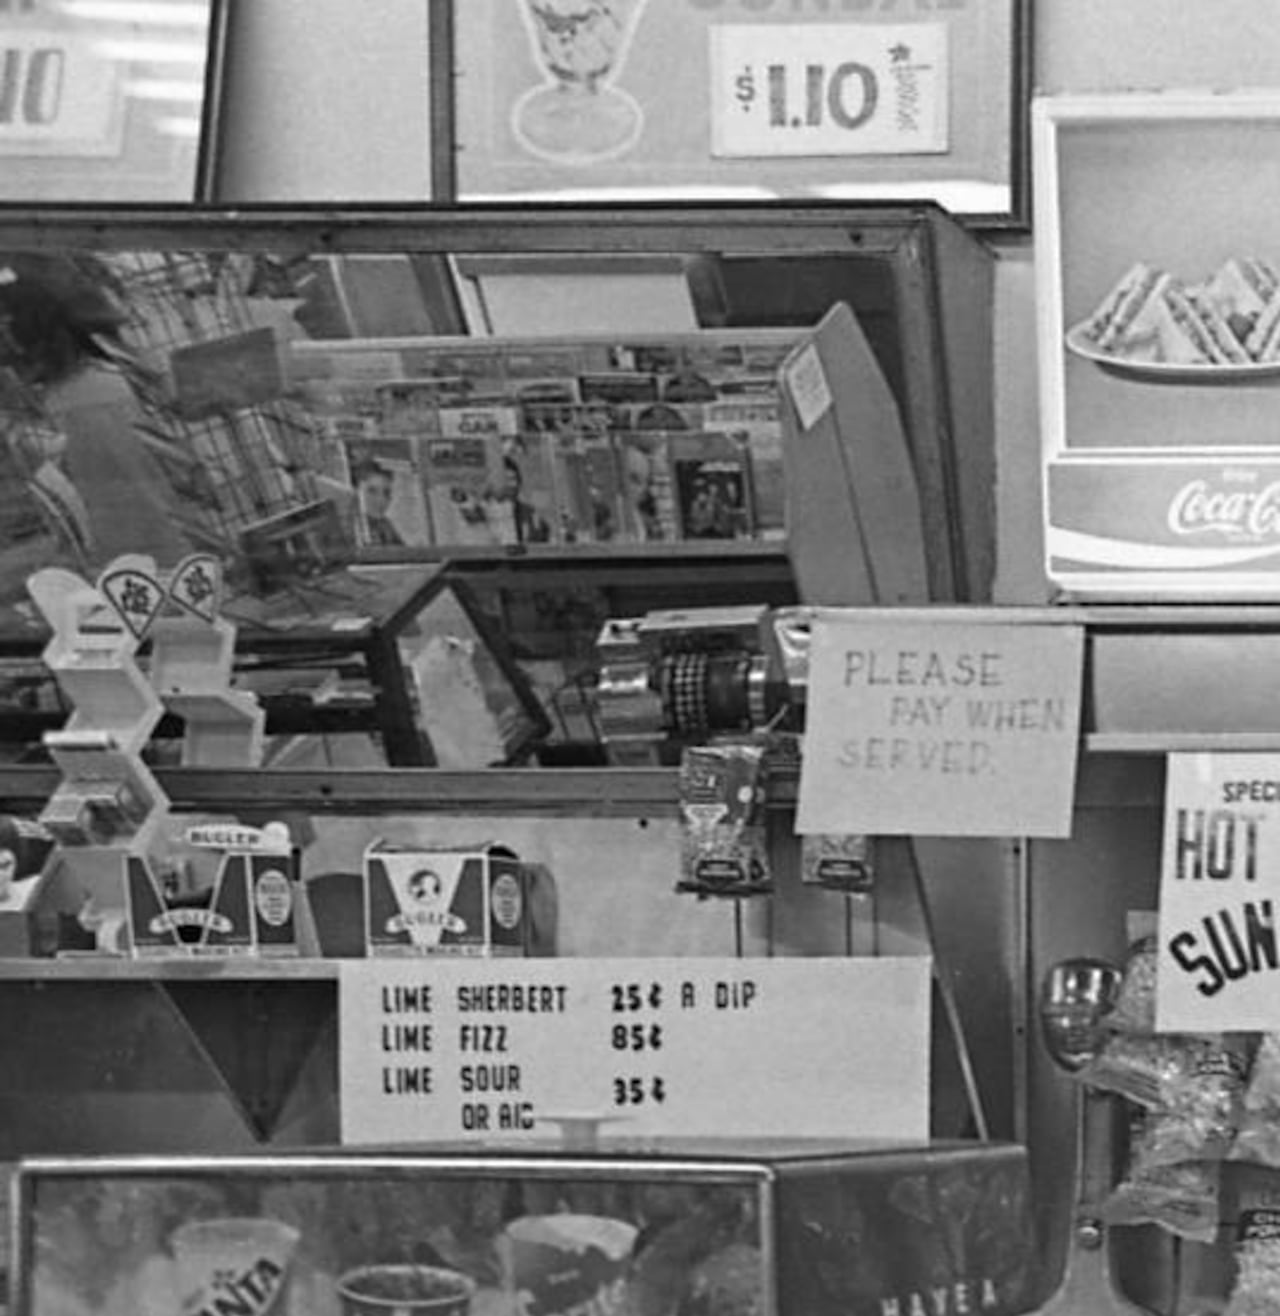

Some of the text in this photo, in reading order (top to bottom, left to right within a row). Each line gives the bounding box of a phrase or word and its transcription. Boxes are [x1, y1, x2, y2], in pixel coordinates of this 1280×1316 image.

[735, 61, 880, 131] $1.10
[844, 651, 1004, 687] PLEASE
[890, 697, 1066, 731] PAY WHEN
[1176, 809, 1265, 881] HOT
[381, 985, 432, 1013] LIME
[457, 985, 568, 1013] SHERBERT
[681, 982, 695, 1009] A
[715, 982, 756, 1009] DIP
[381, 1025, 432, 1052] LIME
[460, 1025, 508, 1052] FIZZ
[382, 1066, 432, 1094] LIME
[460, 1065, 521, 1093] SOUR
[462, 1104, 490, 1130] OR
